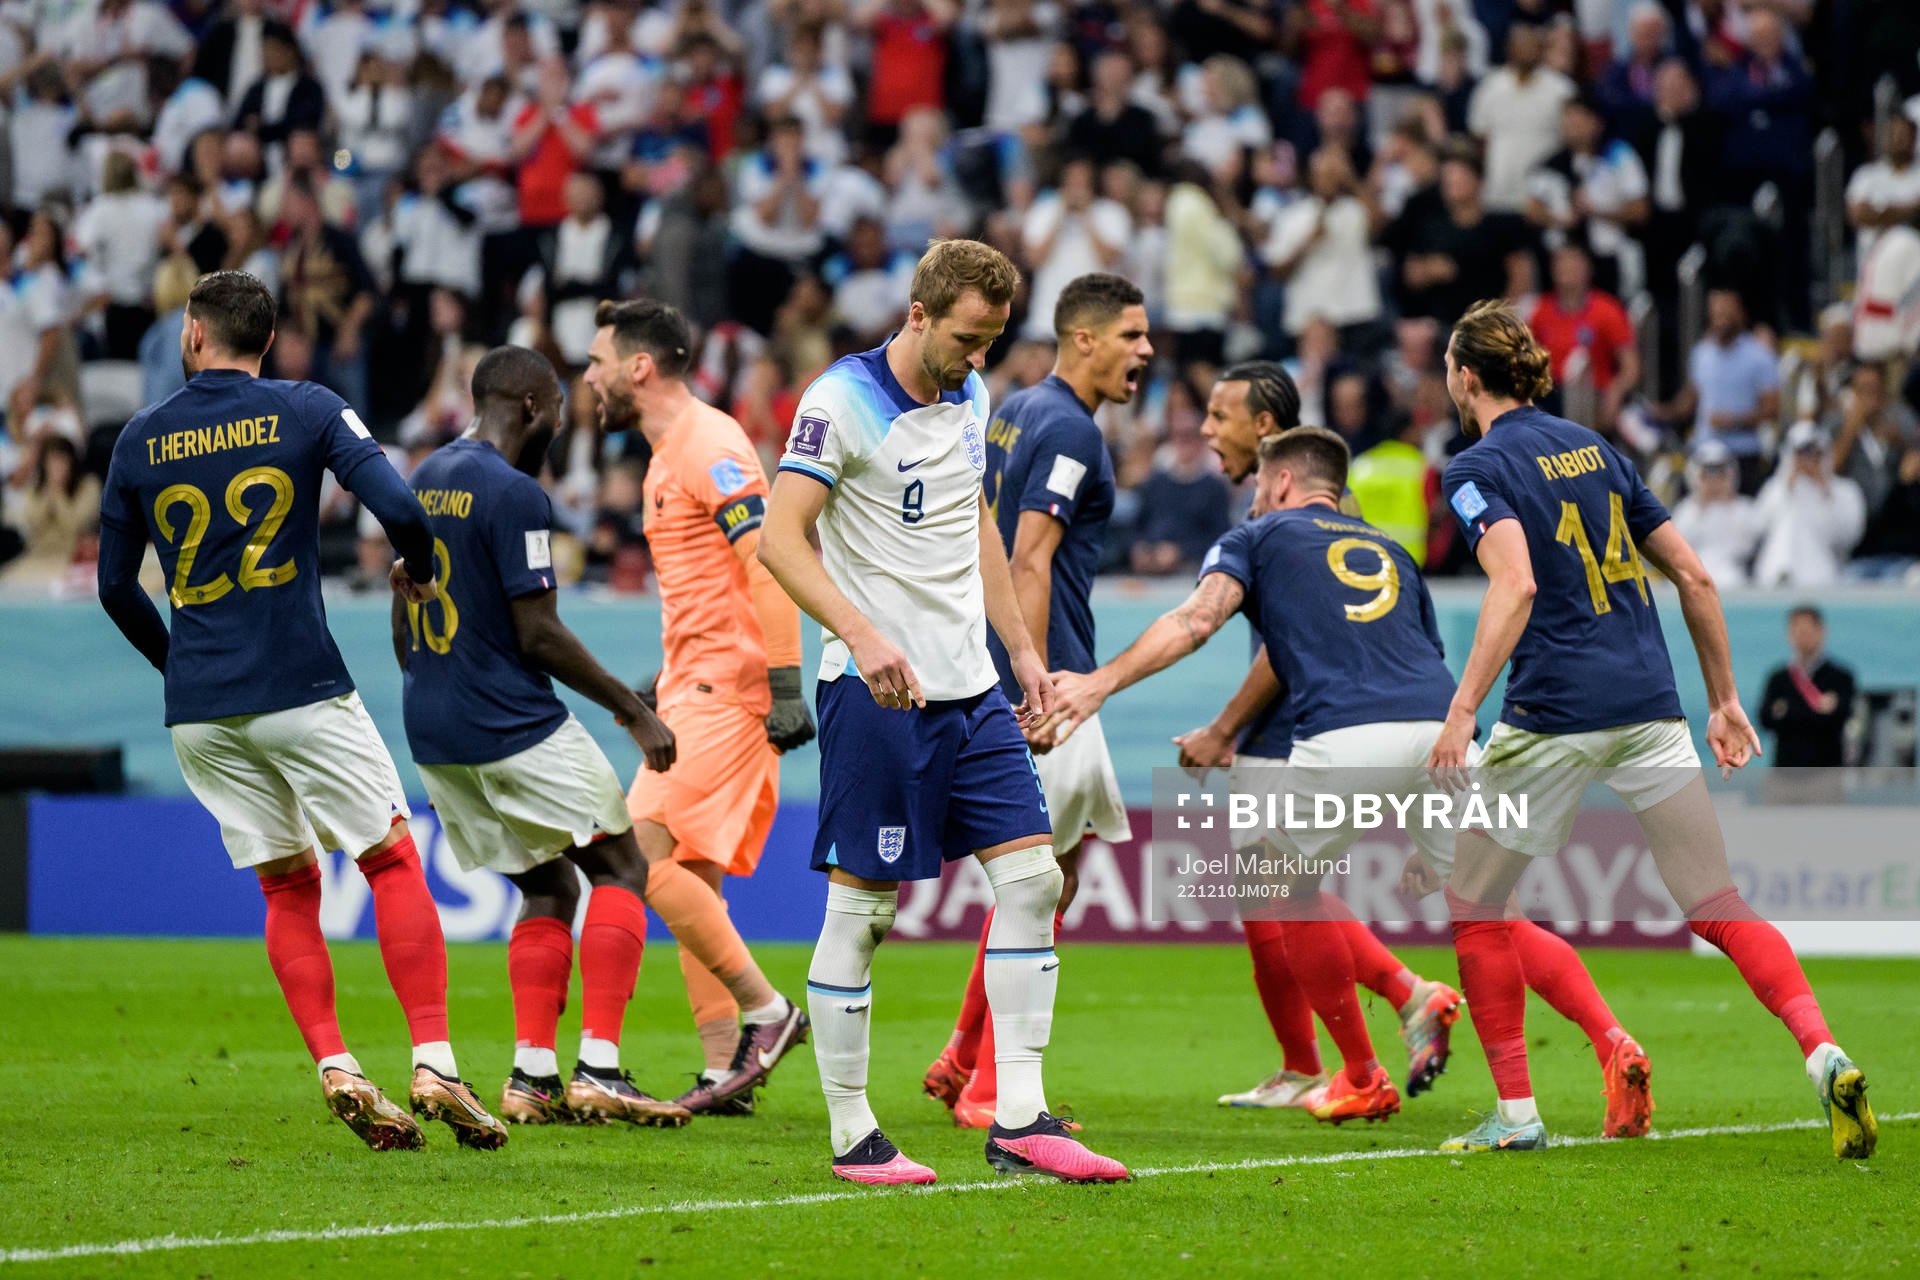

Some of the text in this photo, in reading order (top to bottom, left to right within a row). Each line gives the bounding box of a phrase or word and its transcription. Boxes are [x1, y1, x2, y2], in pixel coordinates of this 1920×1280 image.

[147, 415, 280, 465] T.HERNANDEZ
[1537, 445, 1606, 481] RABIOT
[724, 503, 750, 528] NO
[902, 478, 924, 524] 9
[154, 466, 298, 609] 22
[1555, 490, 1650, 615] 14
[1326, 538, 1400, 623] 9
[1730, 862, 1920, 910] QatarE
